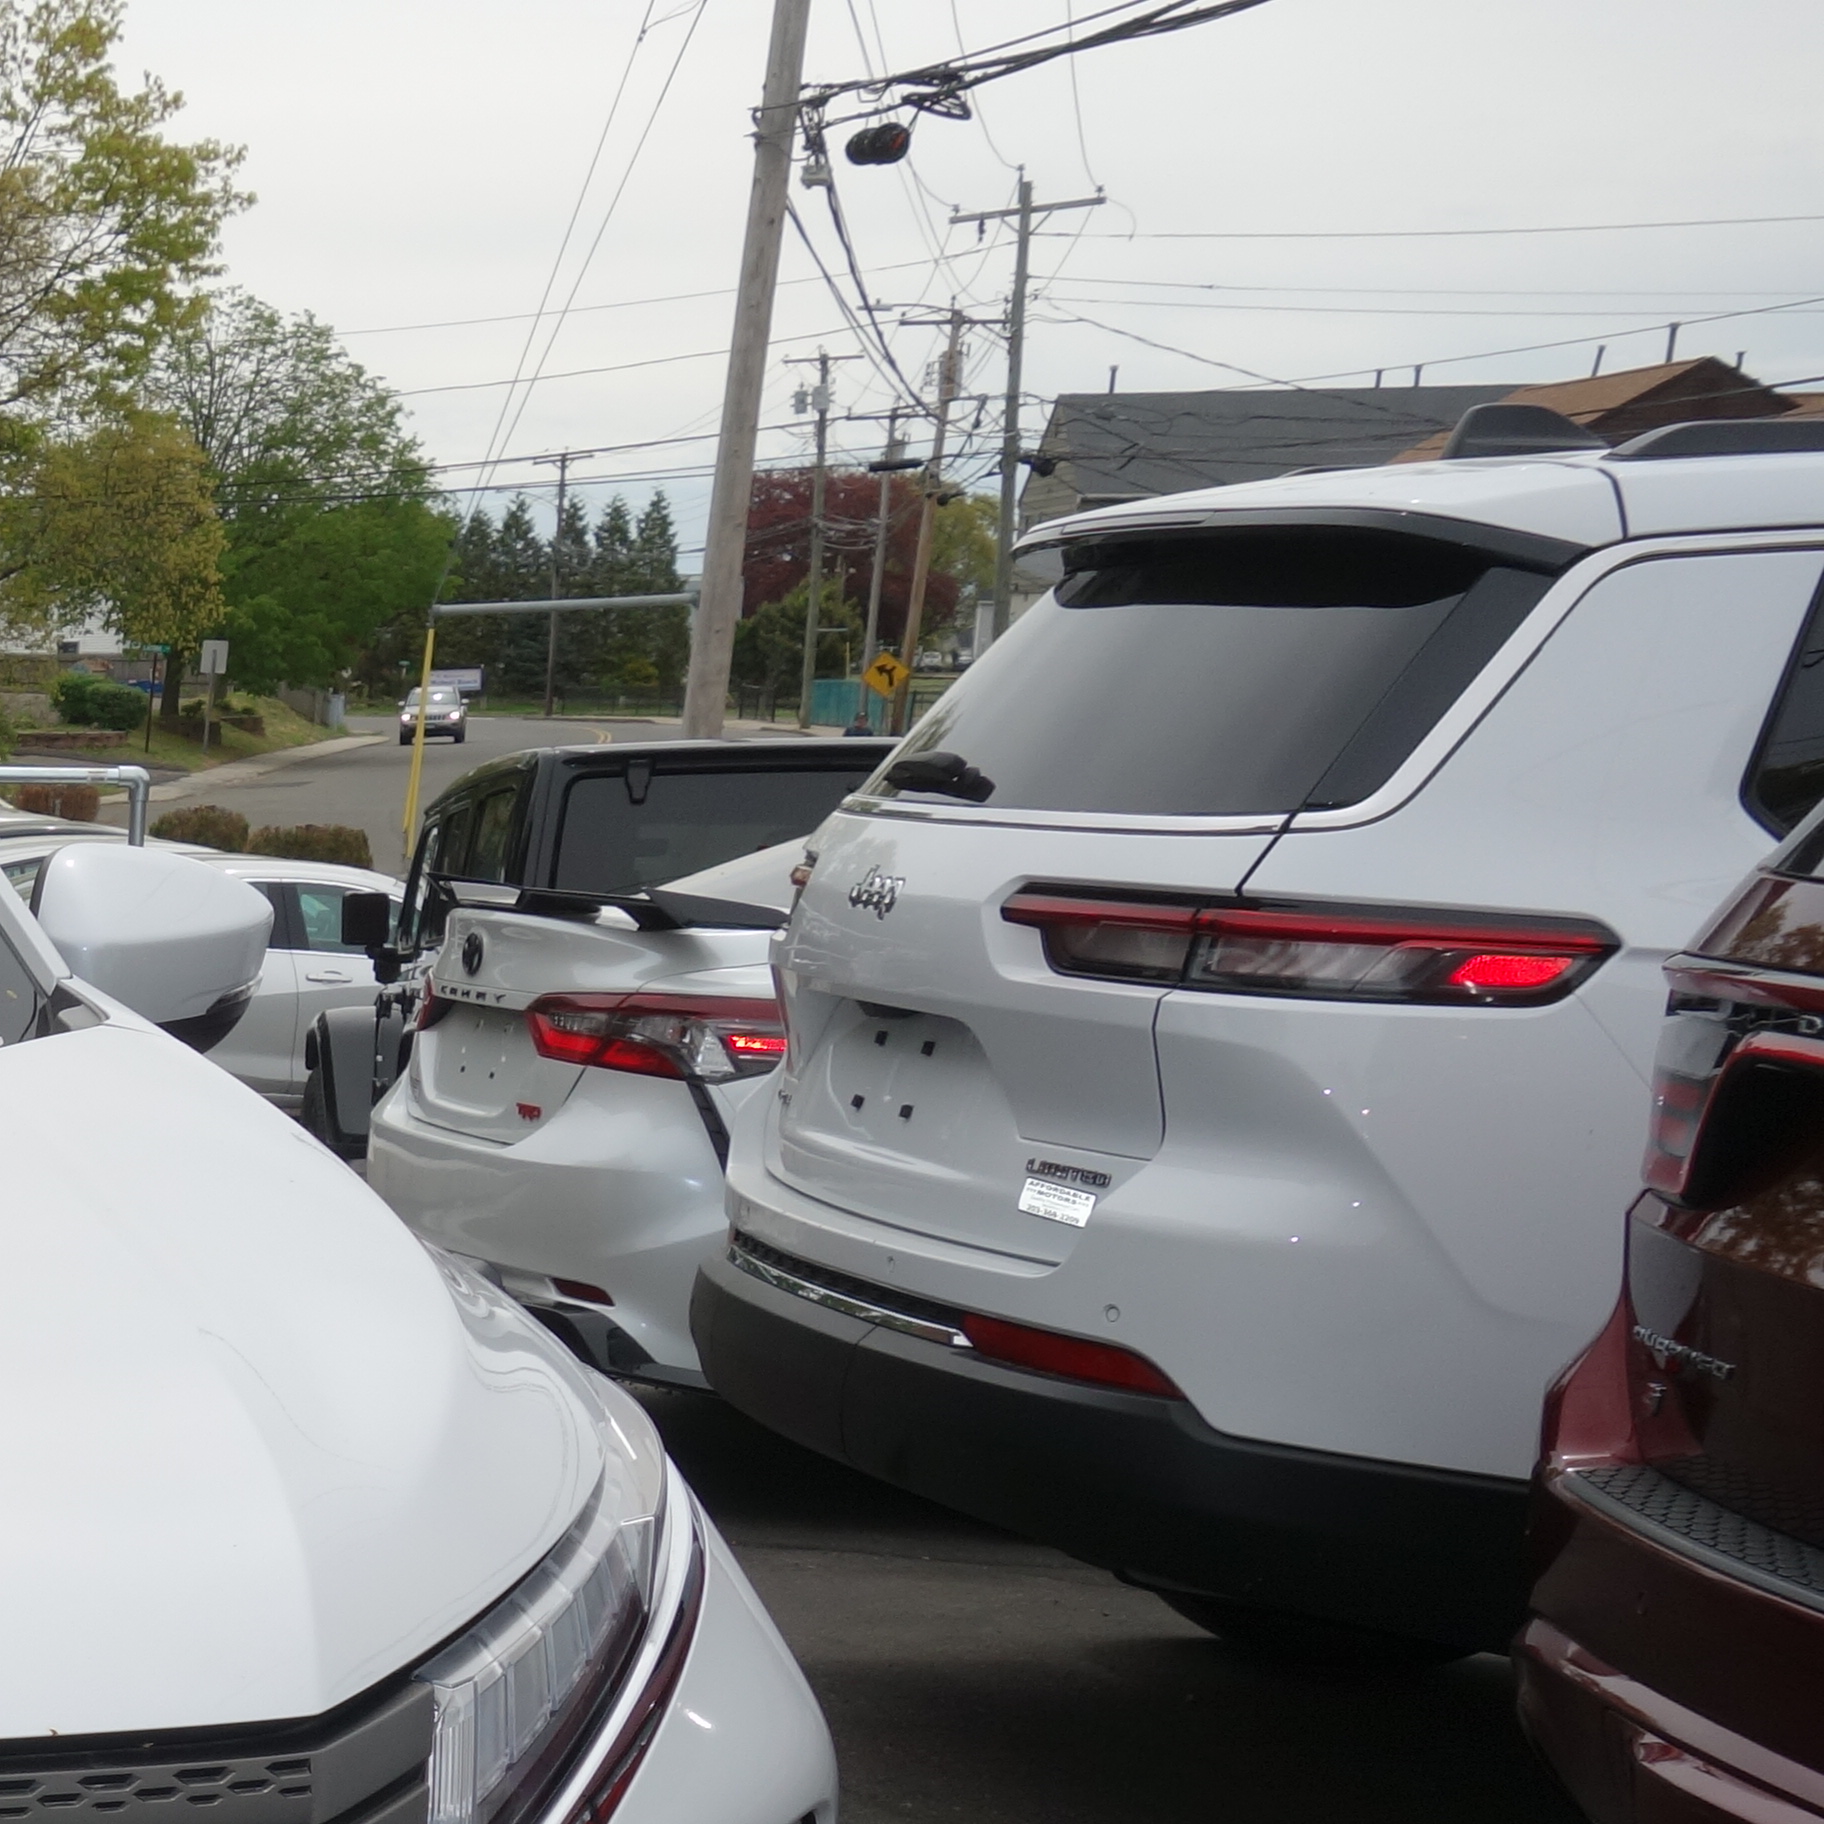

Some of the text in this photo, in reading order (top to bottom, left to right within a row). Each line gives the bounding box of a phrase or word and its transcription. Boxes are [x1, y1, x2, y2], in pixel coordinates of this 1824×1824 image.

[1026, 1158, 1112, 1188] LIMITED
[1028, 1180, 1091, 1202] AFFORDABLE
[1036, 1190, 1078, 1205] MOTORS
